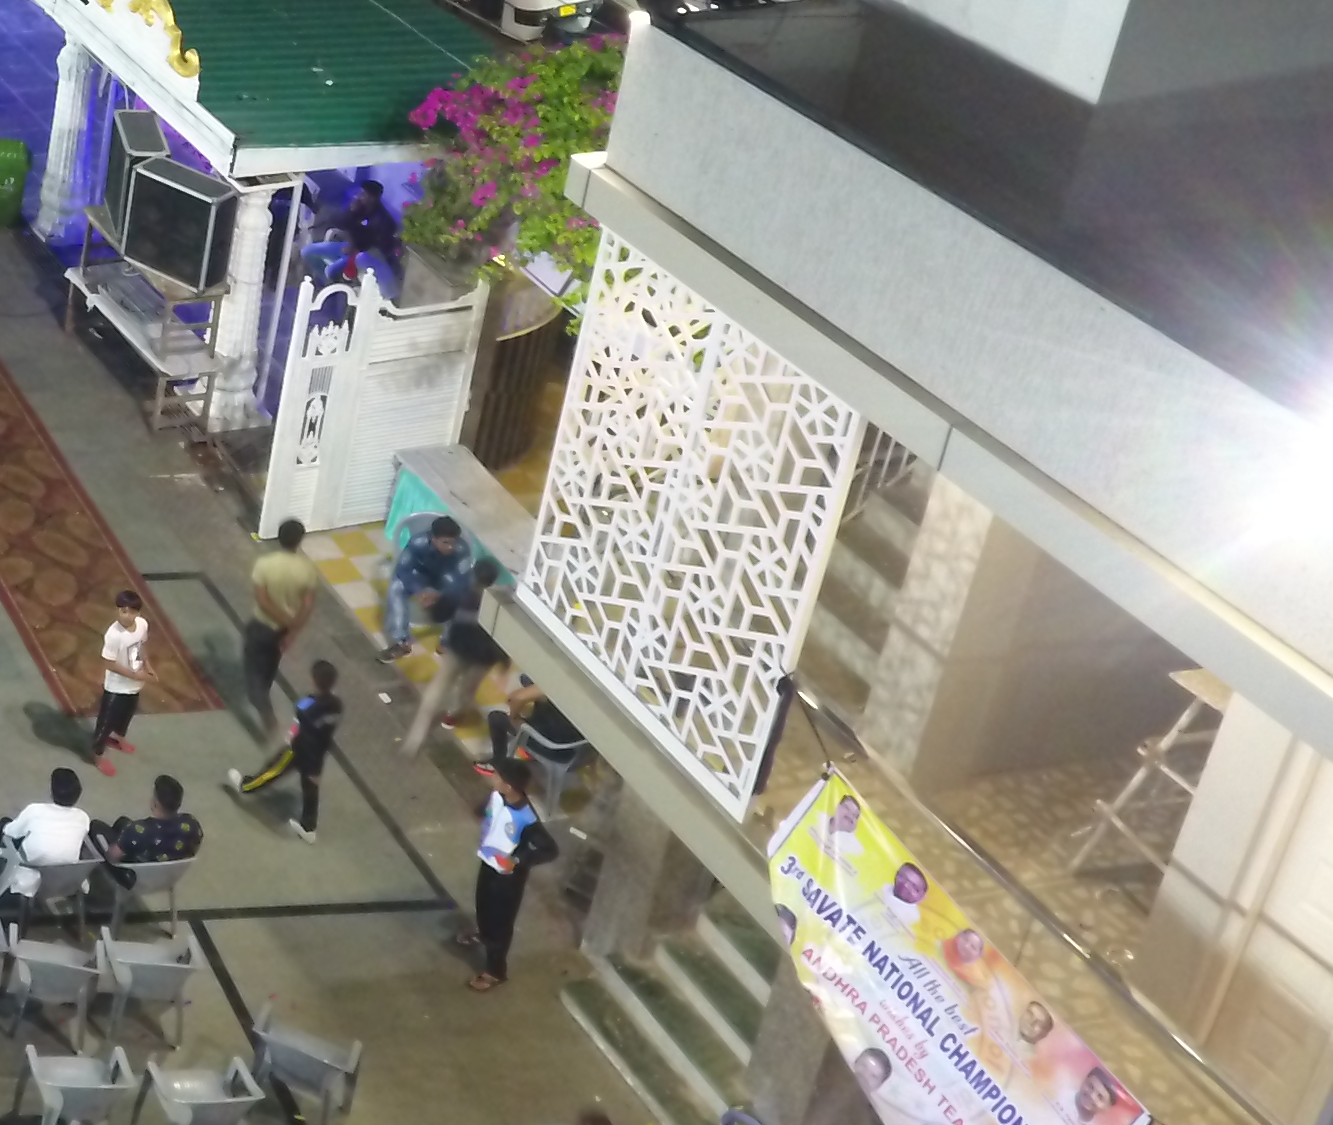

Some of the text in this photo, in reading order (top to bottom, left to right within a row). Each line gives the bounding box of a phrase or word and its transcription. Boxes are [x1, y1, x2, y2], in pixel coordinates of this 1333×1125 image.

[780, 855, 805, 880] 3rd
[801, 878, 867, 944] SAVATE
[862, 940, 941, 1038] NATIONAL
[897, 954, 979, 1037] All the best
[801, 948, 868, 1016] ANDHRA
[868, 1013, 937, 1096] PRADESH
